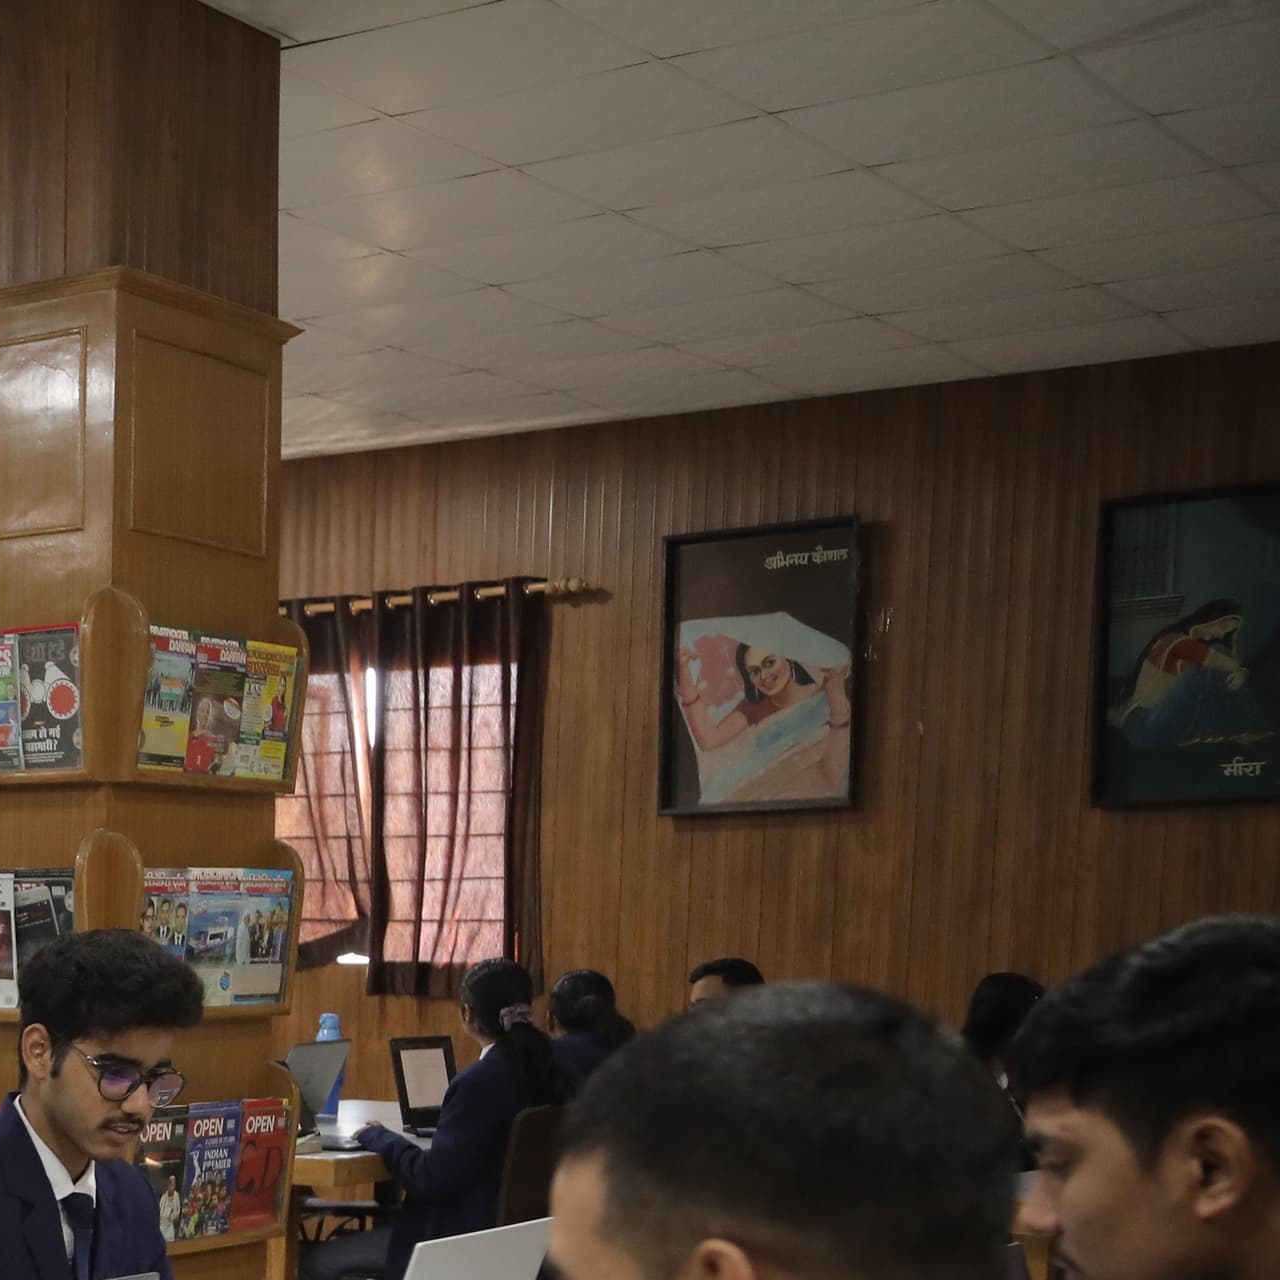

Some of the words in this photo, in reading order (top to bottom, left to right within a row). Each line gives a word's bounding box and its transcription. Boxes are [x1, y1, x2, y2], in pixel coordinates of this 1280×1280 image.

[140, 1121, 172, 1142] OPEN
[193, 1117, 224, 1138] OPEN
[245, 1115, 275, 1134] OPEN
[204, 1147, 229, 1160] INDIAN
